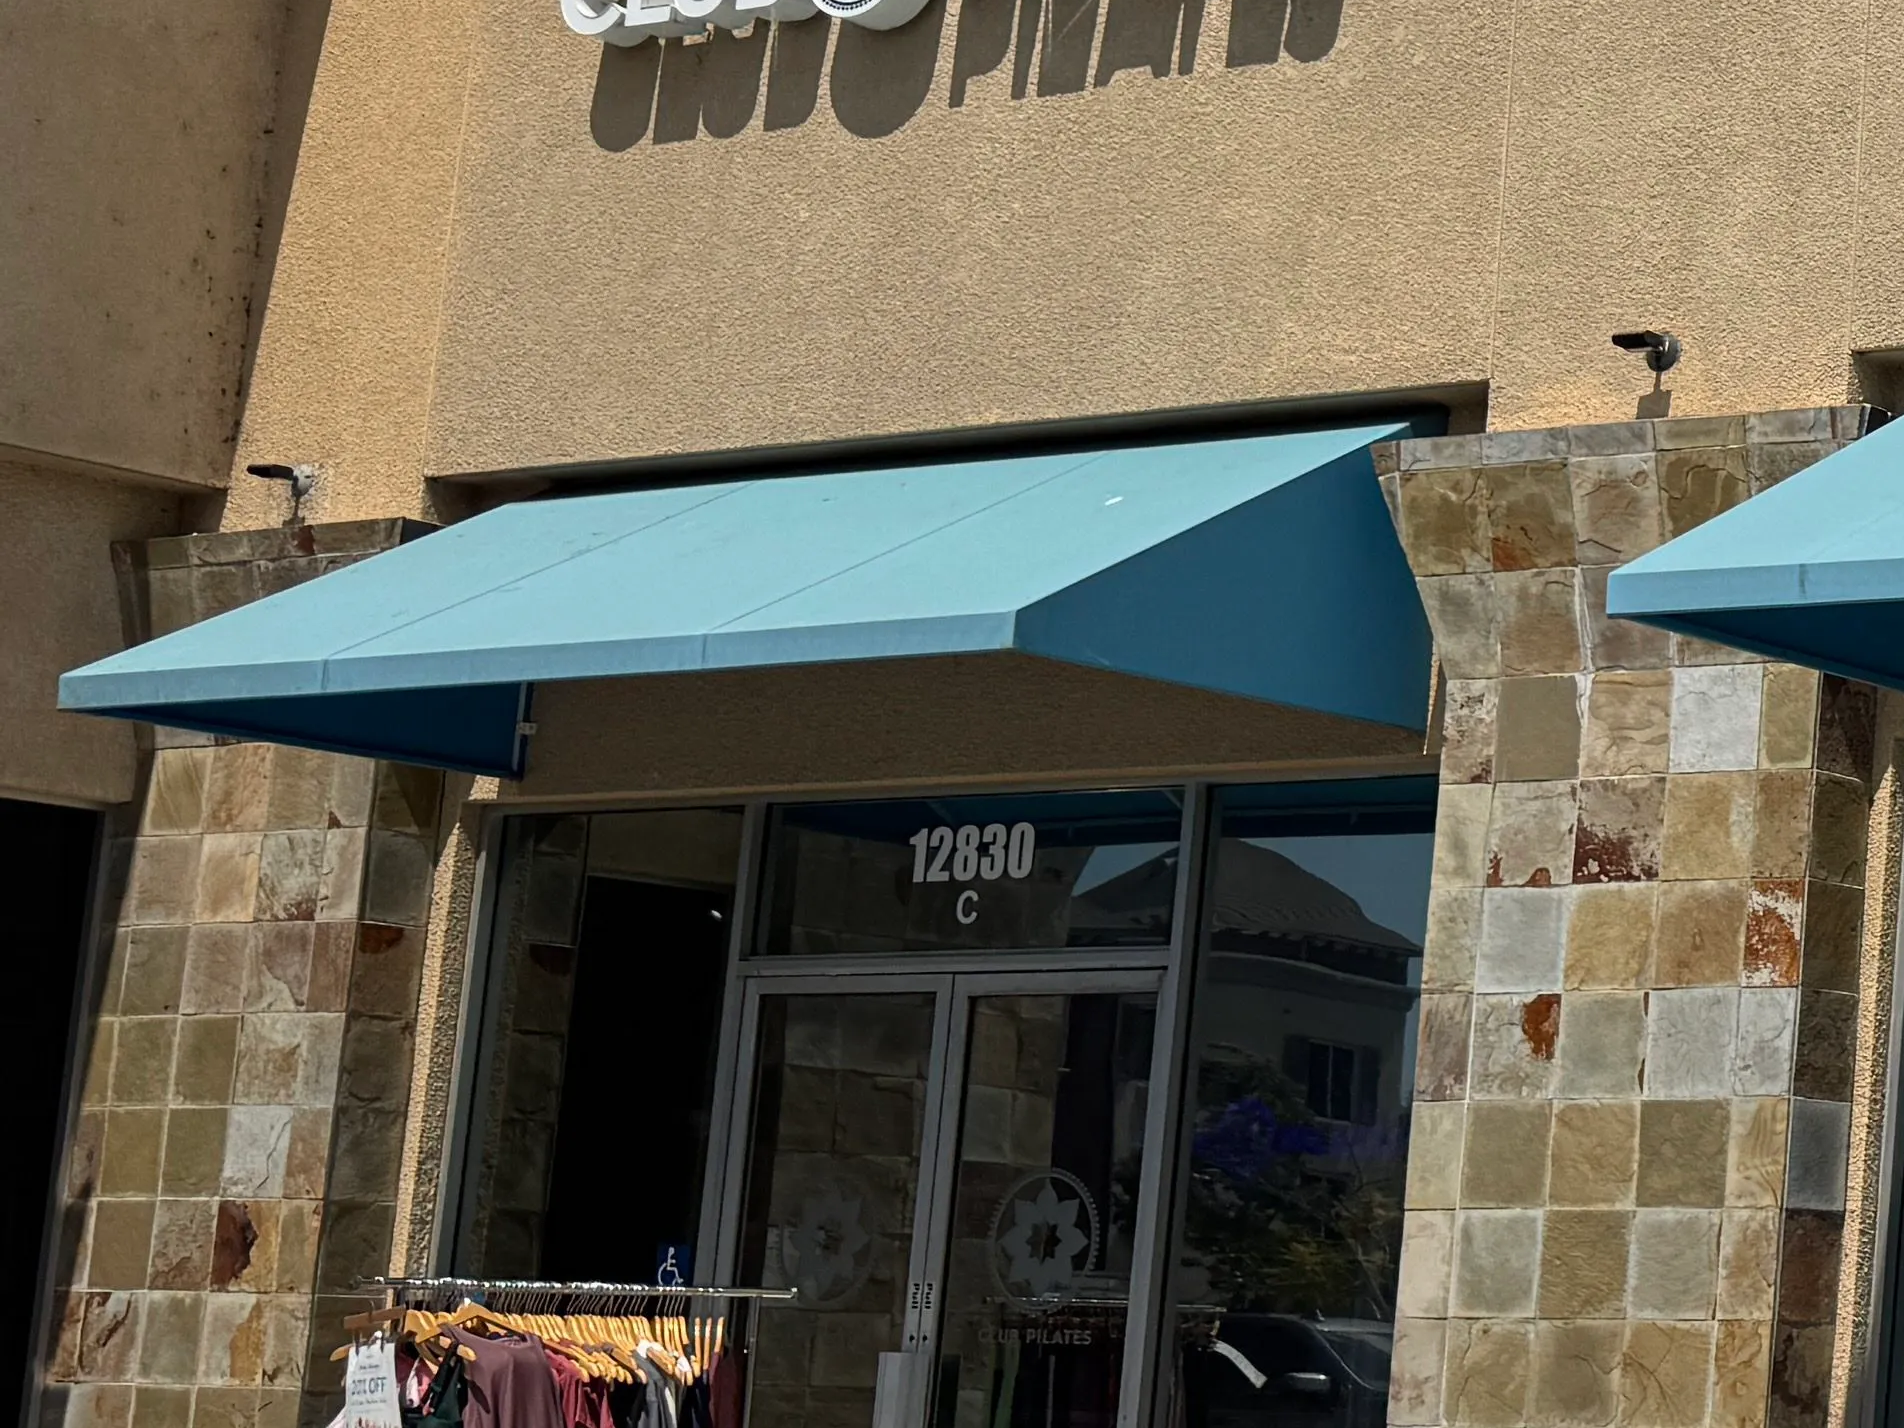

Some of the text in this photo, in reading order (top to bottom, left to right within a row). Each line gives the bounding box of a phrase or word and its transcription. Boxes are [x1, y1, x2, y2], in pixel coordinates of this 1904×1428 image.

[908, 821, 1036, 883] 12830
[956, 889, 980, 924] C
[911, 1282, 921, 1310] Pull
[924, 1282, 934, 1310] Pull
[1025, 1328, 1092, 1346] PILATES
[368, 1376, 388, 1394] OFF
